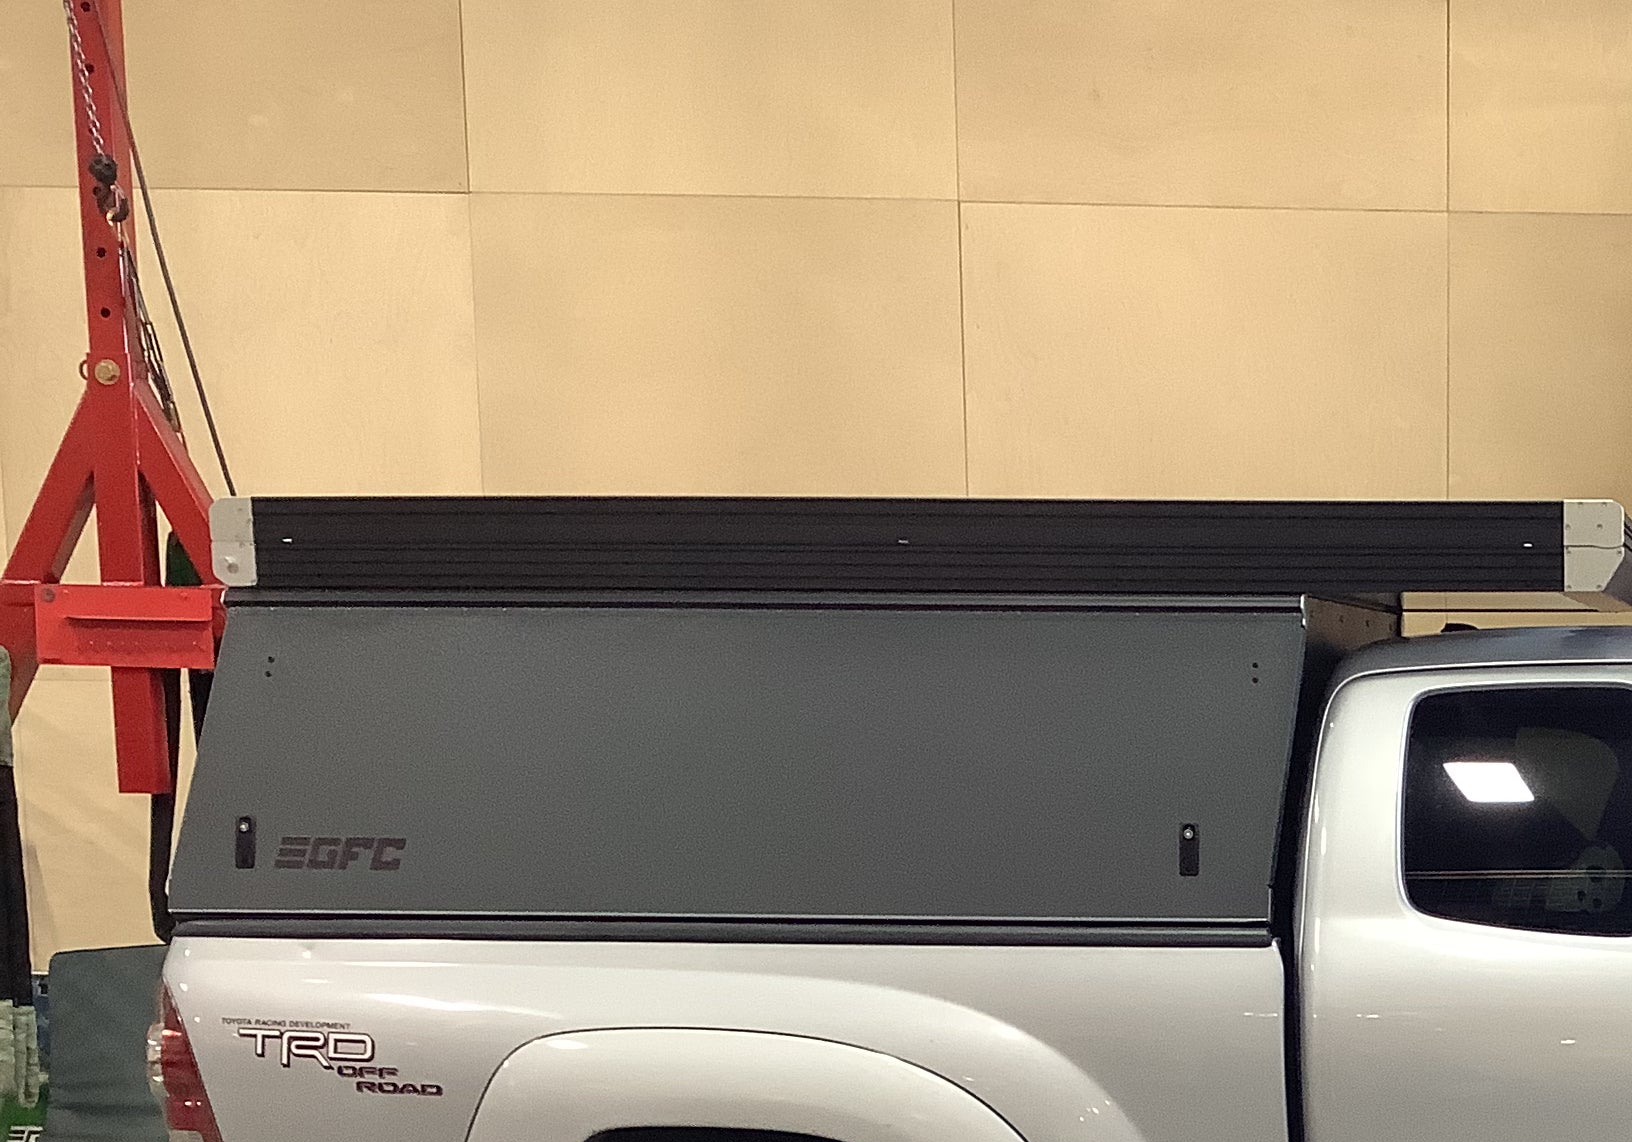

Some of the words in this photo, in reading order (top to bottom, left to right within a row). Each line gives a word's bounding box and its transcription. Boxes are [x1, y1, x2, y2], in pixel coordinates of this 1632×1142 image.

[221, 1017, 252, 1026] TOYOTA
[254, 1018, 287, 1028] RACING
[288, 1020, 352, 1030] DEVELOPMENT
[238, 1027, 375, 1069] TRD
[336, 1065, 399, 1079] OFF
[355, 1080, 444, 1096] ROAD
